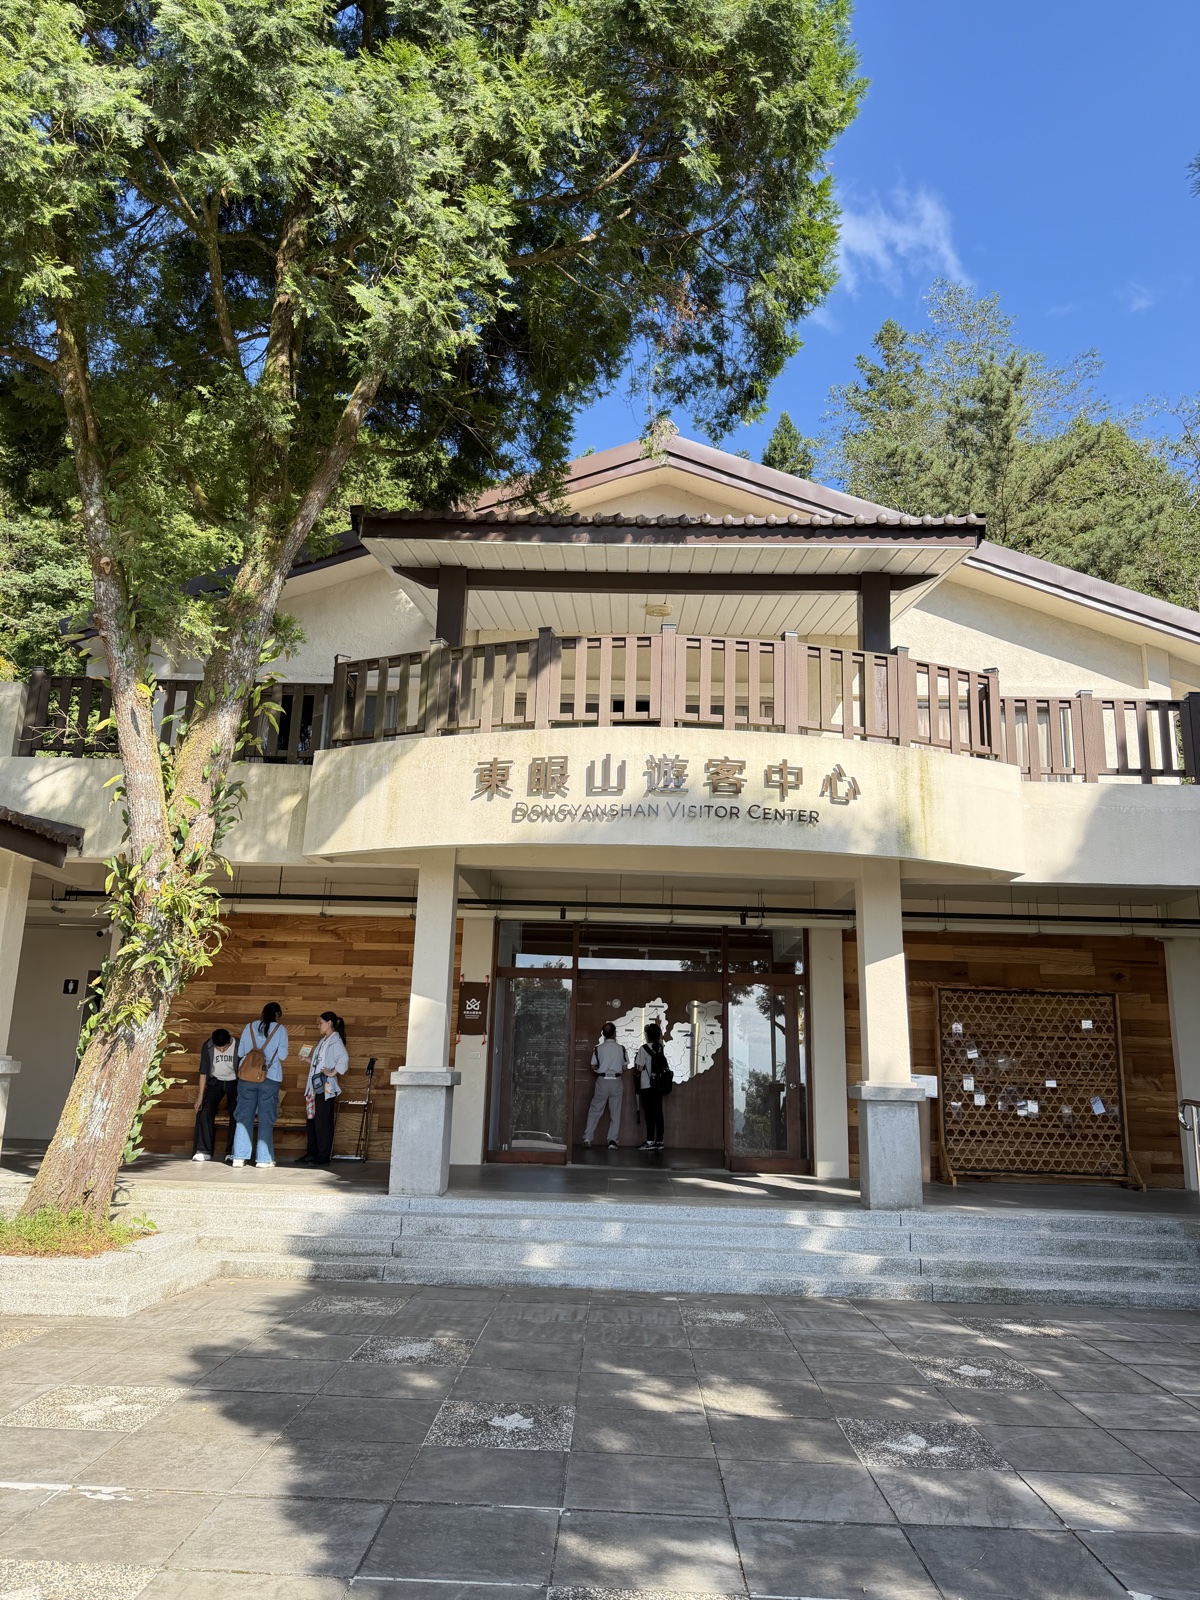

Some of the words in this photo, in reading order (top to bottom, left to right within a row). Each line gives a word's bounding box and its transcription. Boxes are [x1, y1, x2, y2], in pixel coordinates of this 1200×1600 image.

[473, 753, 861, 802] 東眼山遊客中心
[514, 802, 659, 819] DONGYANSHAN
[666, 801, 740, 819] VISITOR
[748, 804, 820, 823] CENTER
